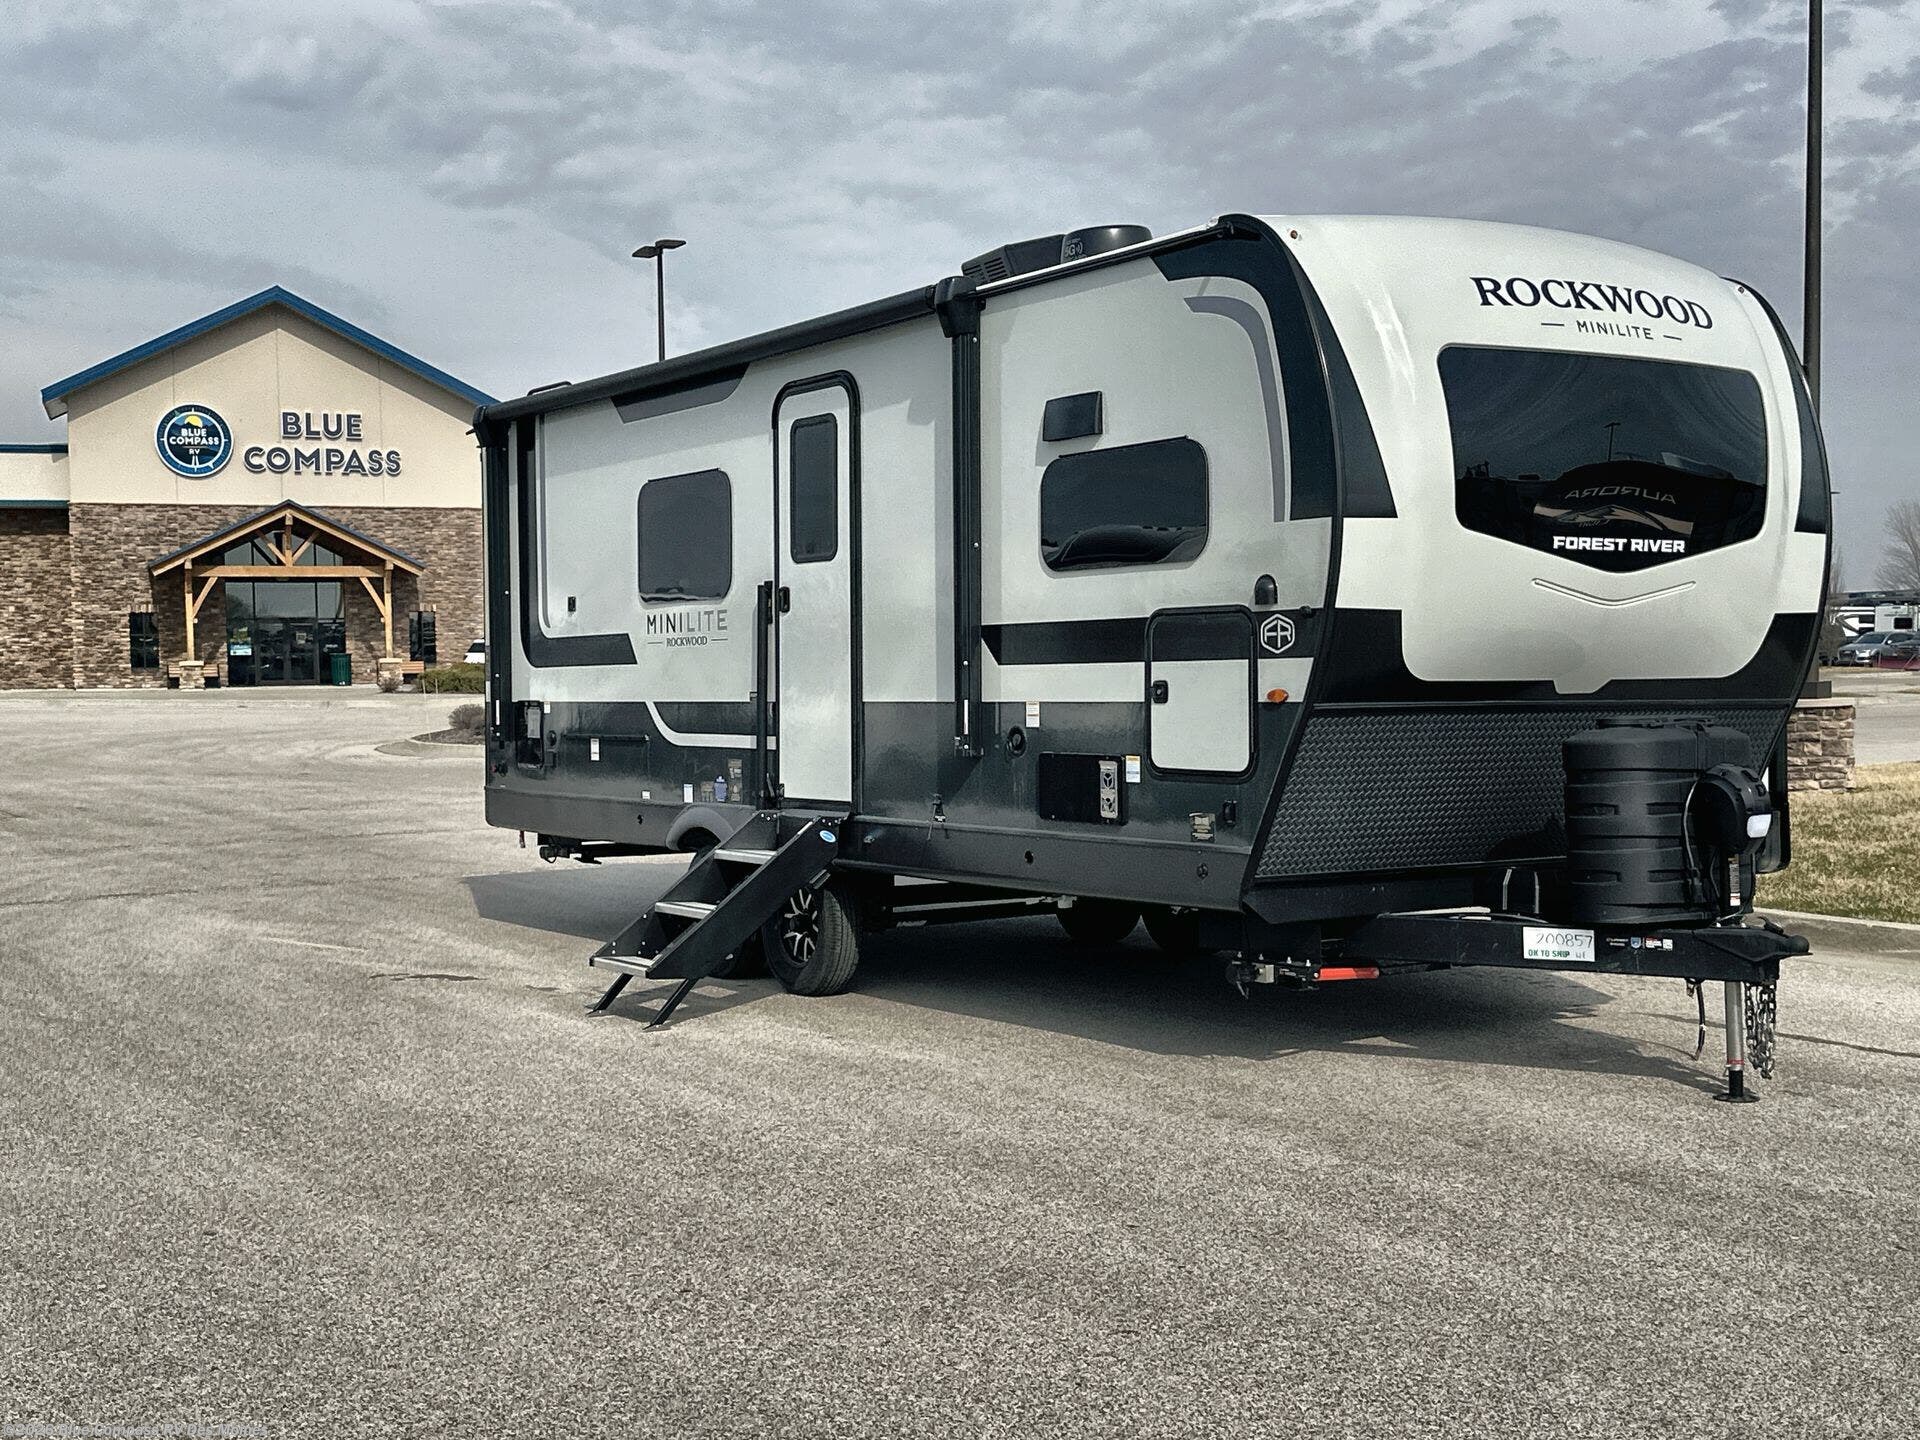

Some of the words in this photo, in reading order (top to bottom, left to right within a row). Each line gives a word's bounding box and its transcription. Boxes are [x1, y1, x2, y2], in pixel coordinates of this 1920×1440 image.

[1470, 276, 1713, 330] ROCKWOOD
[1576, 320, 1655, 340] MINILITE
[180, 428, 207, 437] BLUE
[281, 410, 364, 442] BLUE
[169, 436, 220, 446] COMPASS
[243, 445, 402, 477] COMPASS
[1552, 535, 1628, 552] FOREST
[1630, 537, 1686, 554] RIVER
[646, 609, 728, 635] MINILITE
[665, 635, 708, 647] ROCKWOOD
[1535, 932, 1593, 949] 200857
[1528, 949, 1539, 957] OK
[1540, 949, 1550, 958] TO
